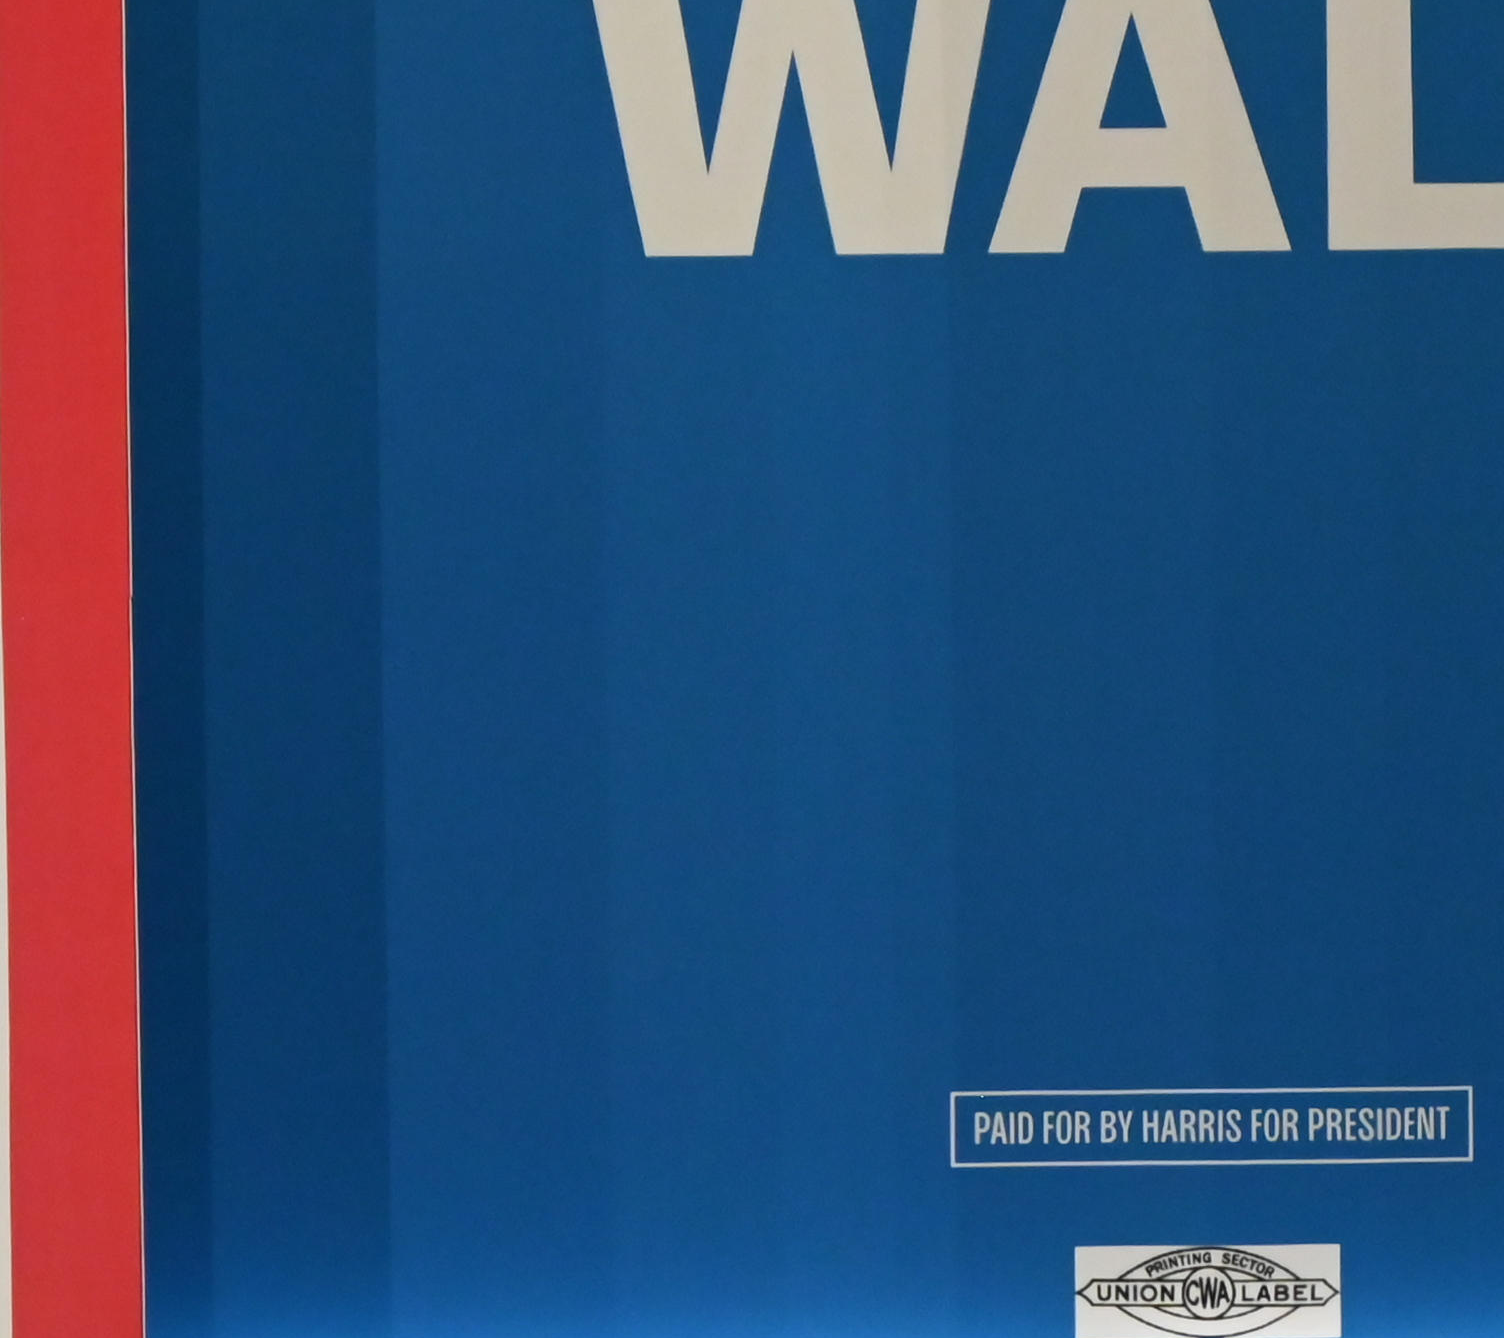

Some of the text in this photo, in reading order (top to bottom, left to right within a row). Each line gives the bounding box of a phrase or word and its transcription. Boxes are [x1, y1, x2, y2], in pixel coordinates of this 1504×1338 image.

[973, 1106, 1452, 1146] PAID FOR BY HARRIS FOR PRESIDENT
[1145, 1252, 1276, 1279] PRINTING SECTOR
[1096, 1276, 1325, 1310] UNION CWA LABEL
